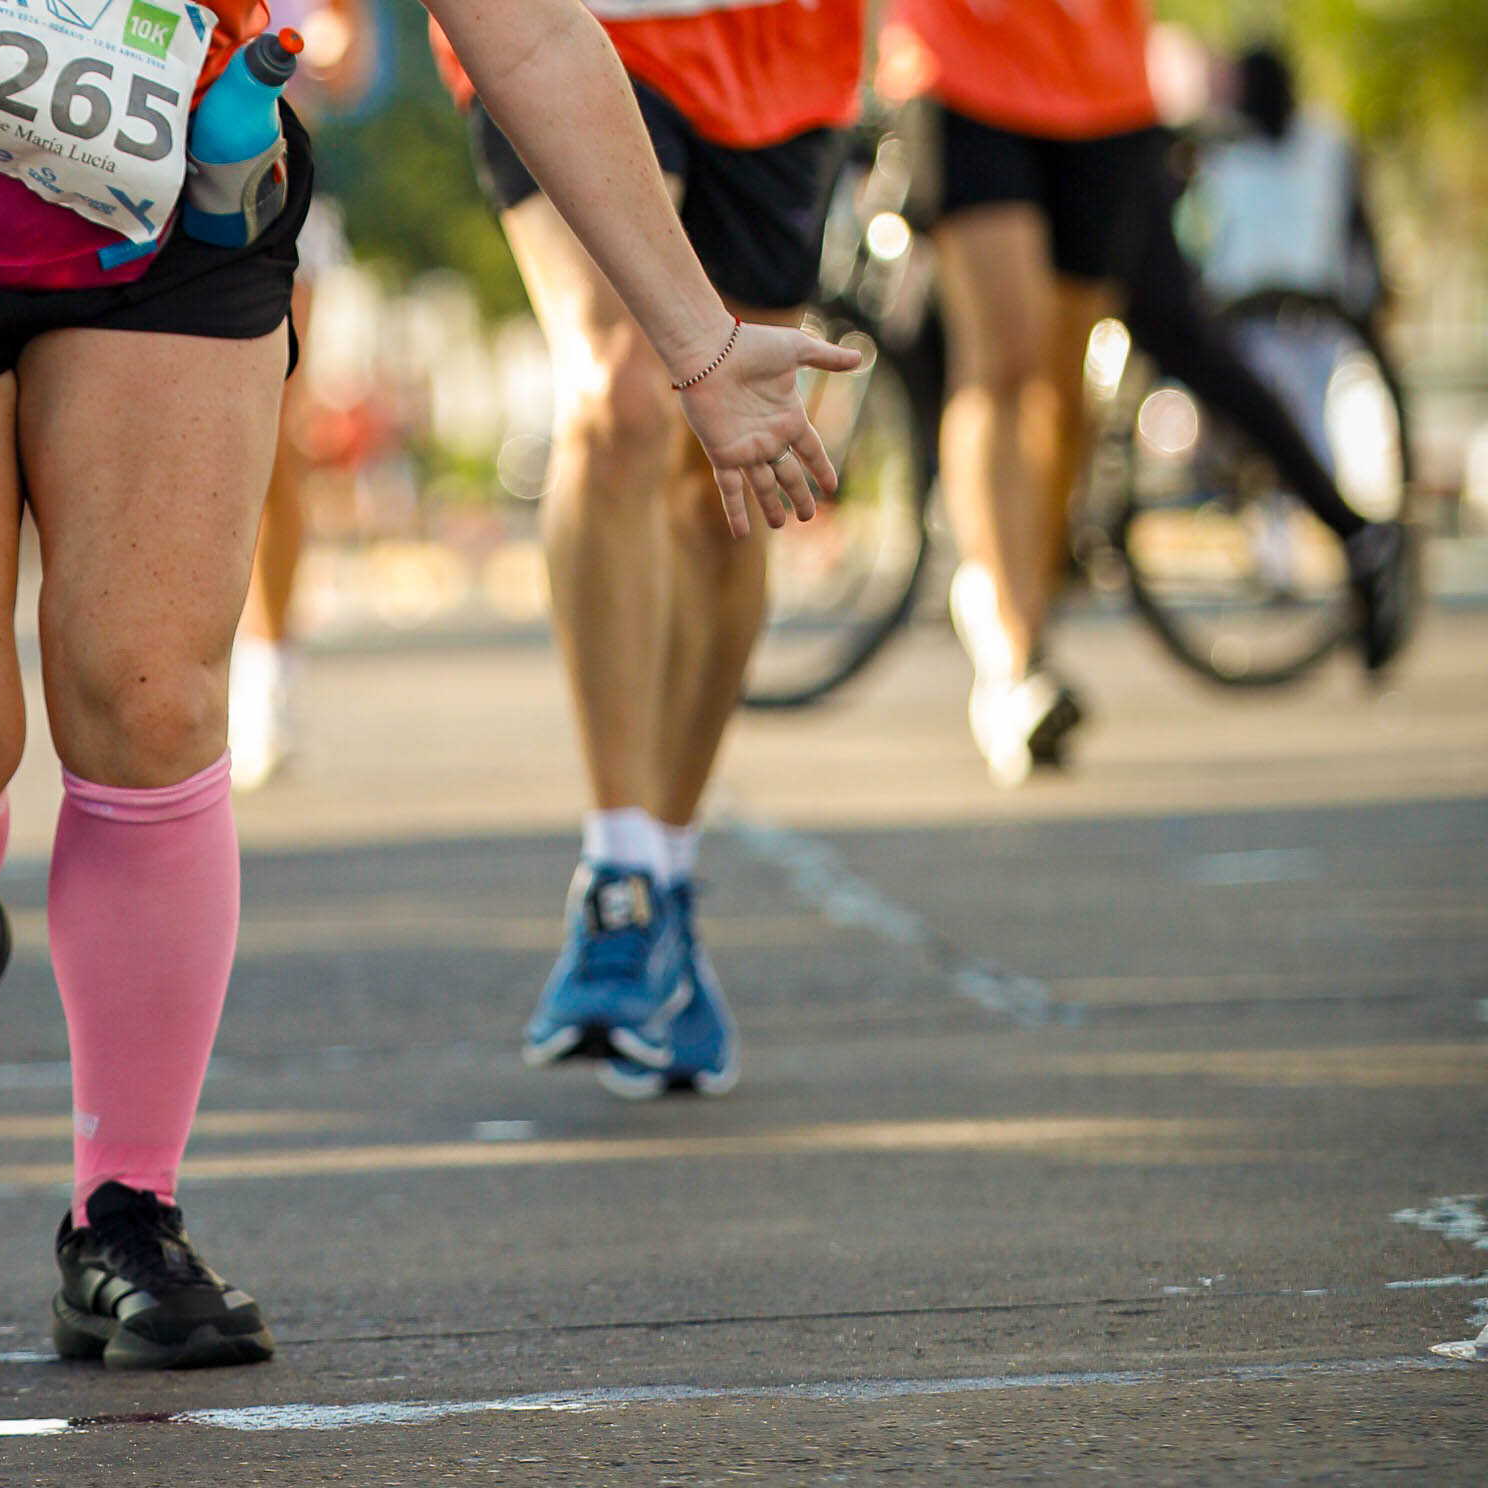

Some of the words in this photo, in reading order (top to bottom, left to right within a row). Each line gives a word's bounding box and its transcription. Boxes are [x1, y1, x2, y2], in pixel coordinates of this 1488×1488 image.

[129, 14, 169, 47] 10K
[14, 125, 64, 156] María
[68, 144, 117, 174] Lucía
